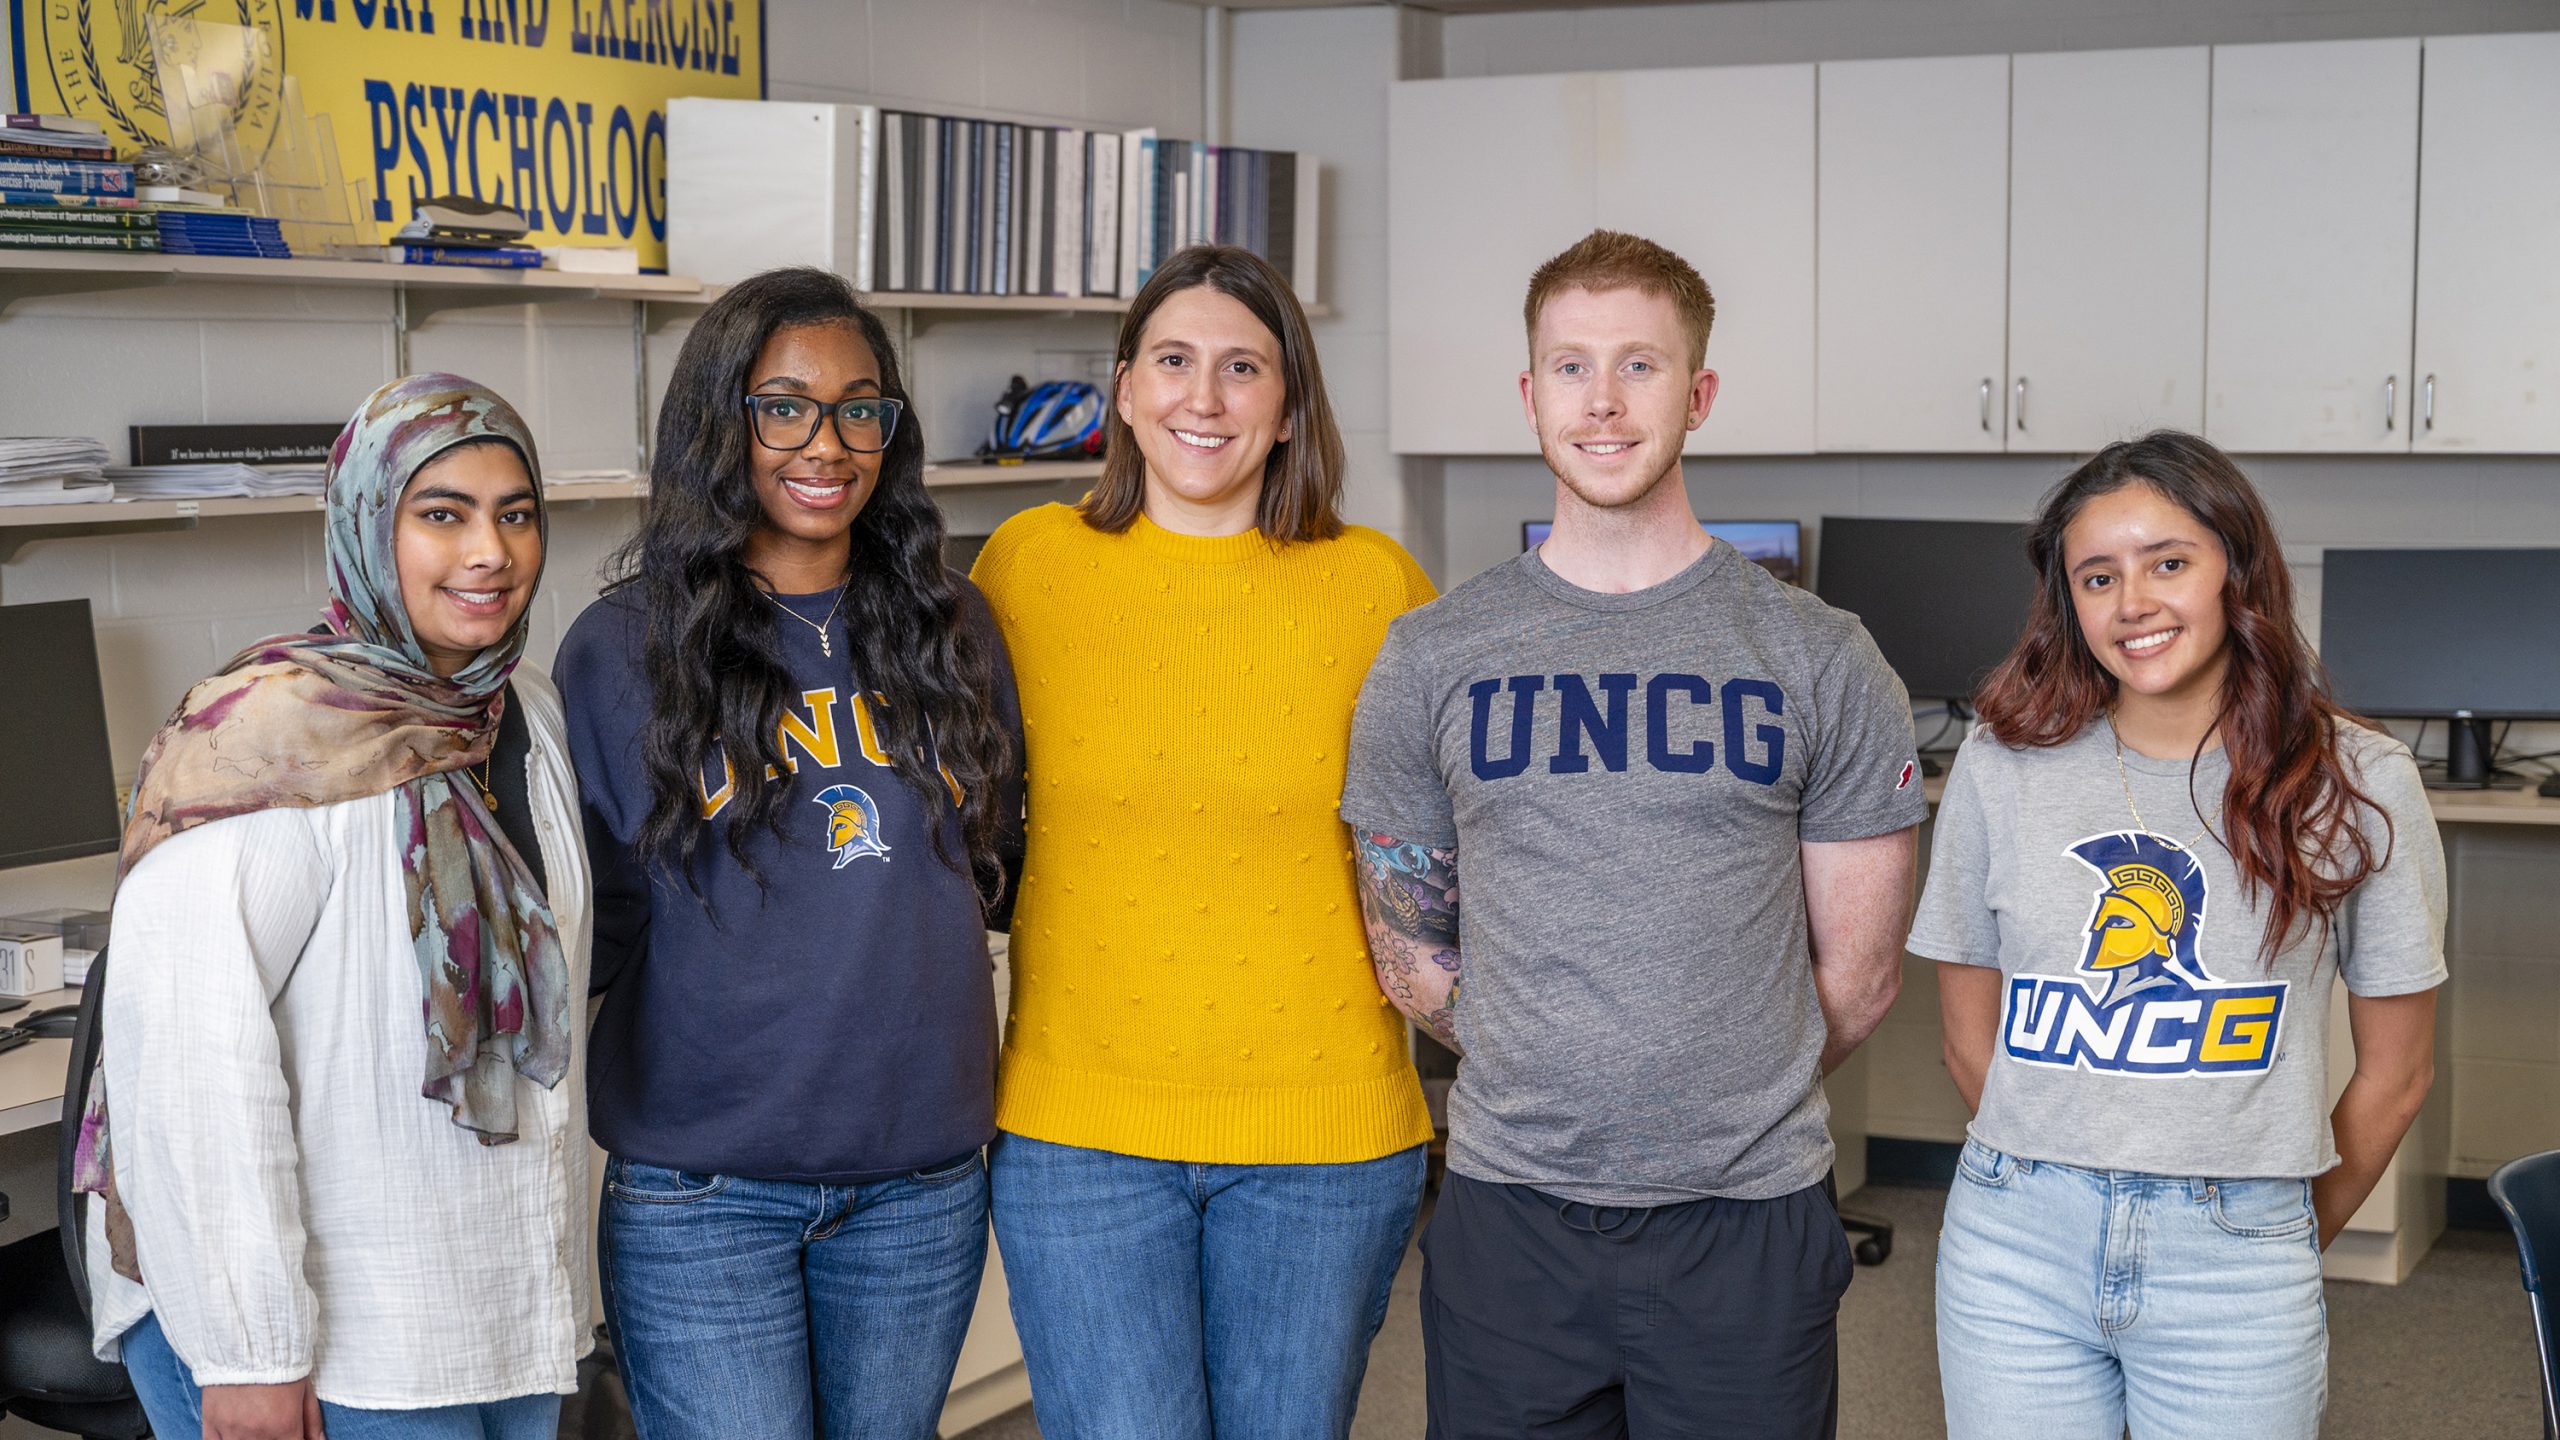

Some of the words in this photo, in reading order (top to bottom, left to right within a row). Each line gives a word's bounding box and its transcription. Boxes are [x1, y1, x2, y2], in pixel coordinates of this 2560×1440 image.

[59, 48, 88, 111] THE
[35, 160, 44, 174] of
[44, 160, 62, 177] Sport
[63, 162, 71, 176] &
[364, 79, 668, 243] PSYCHOLOG
[24, 174, 63, 193] Psychology
[0, 208, 31, 219] ychological
[31, 210, 58, 221] Dynamics
[65, 212, 81, 222] Sport
[82, 213, 92, 222] and
[93, 213, 117, 223] Exercise
[0, 232, 29, 244] chological
[30, 233, 57, 244] Dynamics
[65, 235, 81, 245] Sport
[82, 236, 92, 244] and
[93, 236, 118, 245] Exercise
[171, 449, 178, 459] If
[180, 451, 188, 459] we
[188, 449, 204, 459] knew
[205, 448, 220, 459] what
[221, 450, 230, 459] we
[231, 450, 244, 458] were
[264, 447, 270, 458] it
[296, 446, 303, 456] be
[304, 445, 321, 456] called
[1468, 673, 1785, 785] UNCG
[2006, 985, 2280, 1065] UNCG
